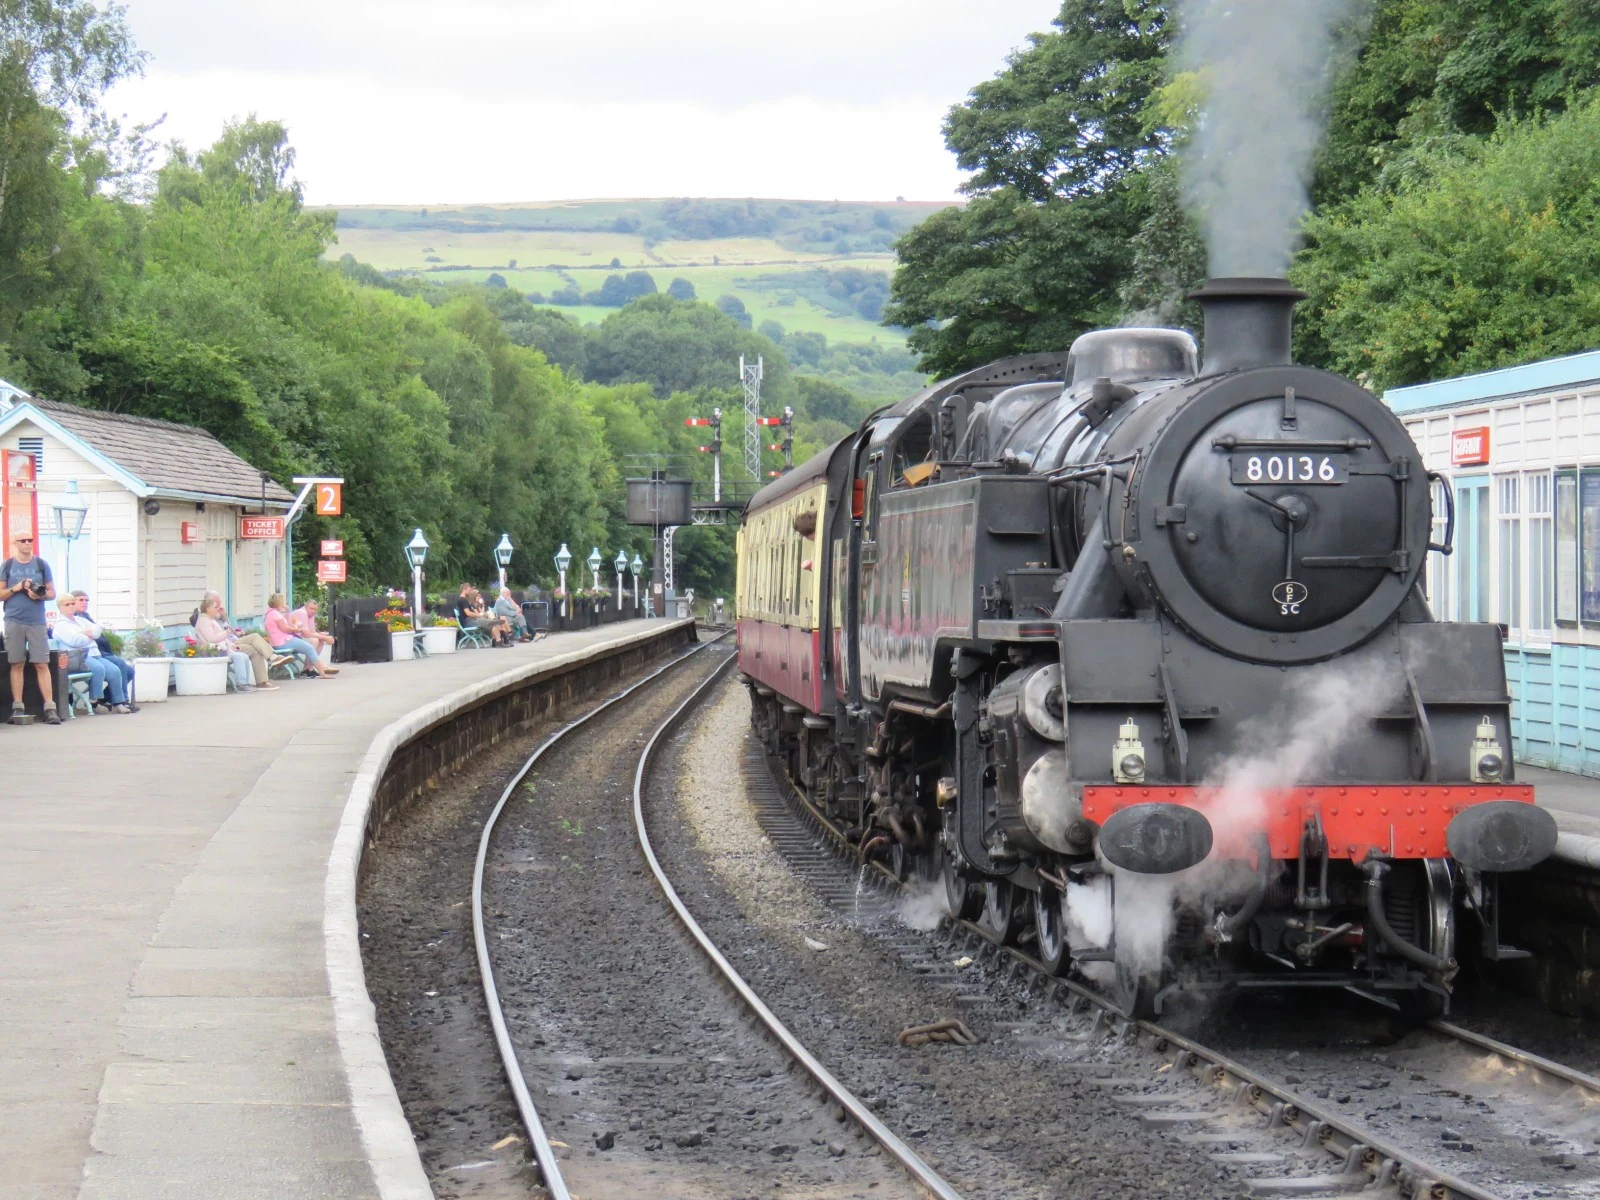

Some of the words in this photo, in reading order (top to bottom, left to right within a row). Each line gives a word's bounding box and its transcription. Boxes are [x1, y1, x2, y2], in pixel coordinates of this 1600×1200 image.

[1247, 456, 1335, 481] 80136
[321, 486, 337, 511] 2
[247, 520, 278, 528] TICKET
[1285, 583, 1294, 594] 6
[1286, 594, 1294, 603] F
[1281, 603, 1300, 615] SC
